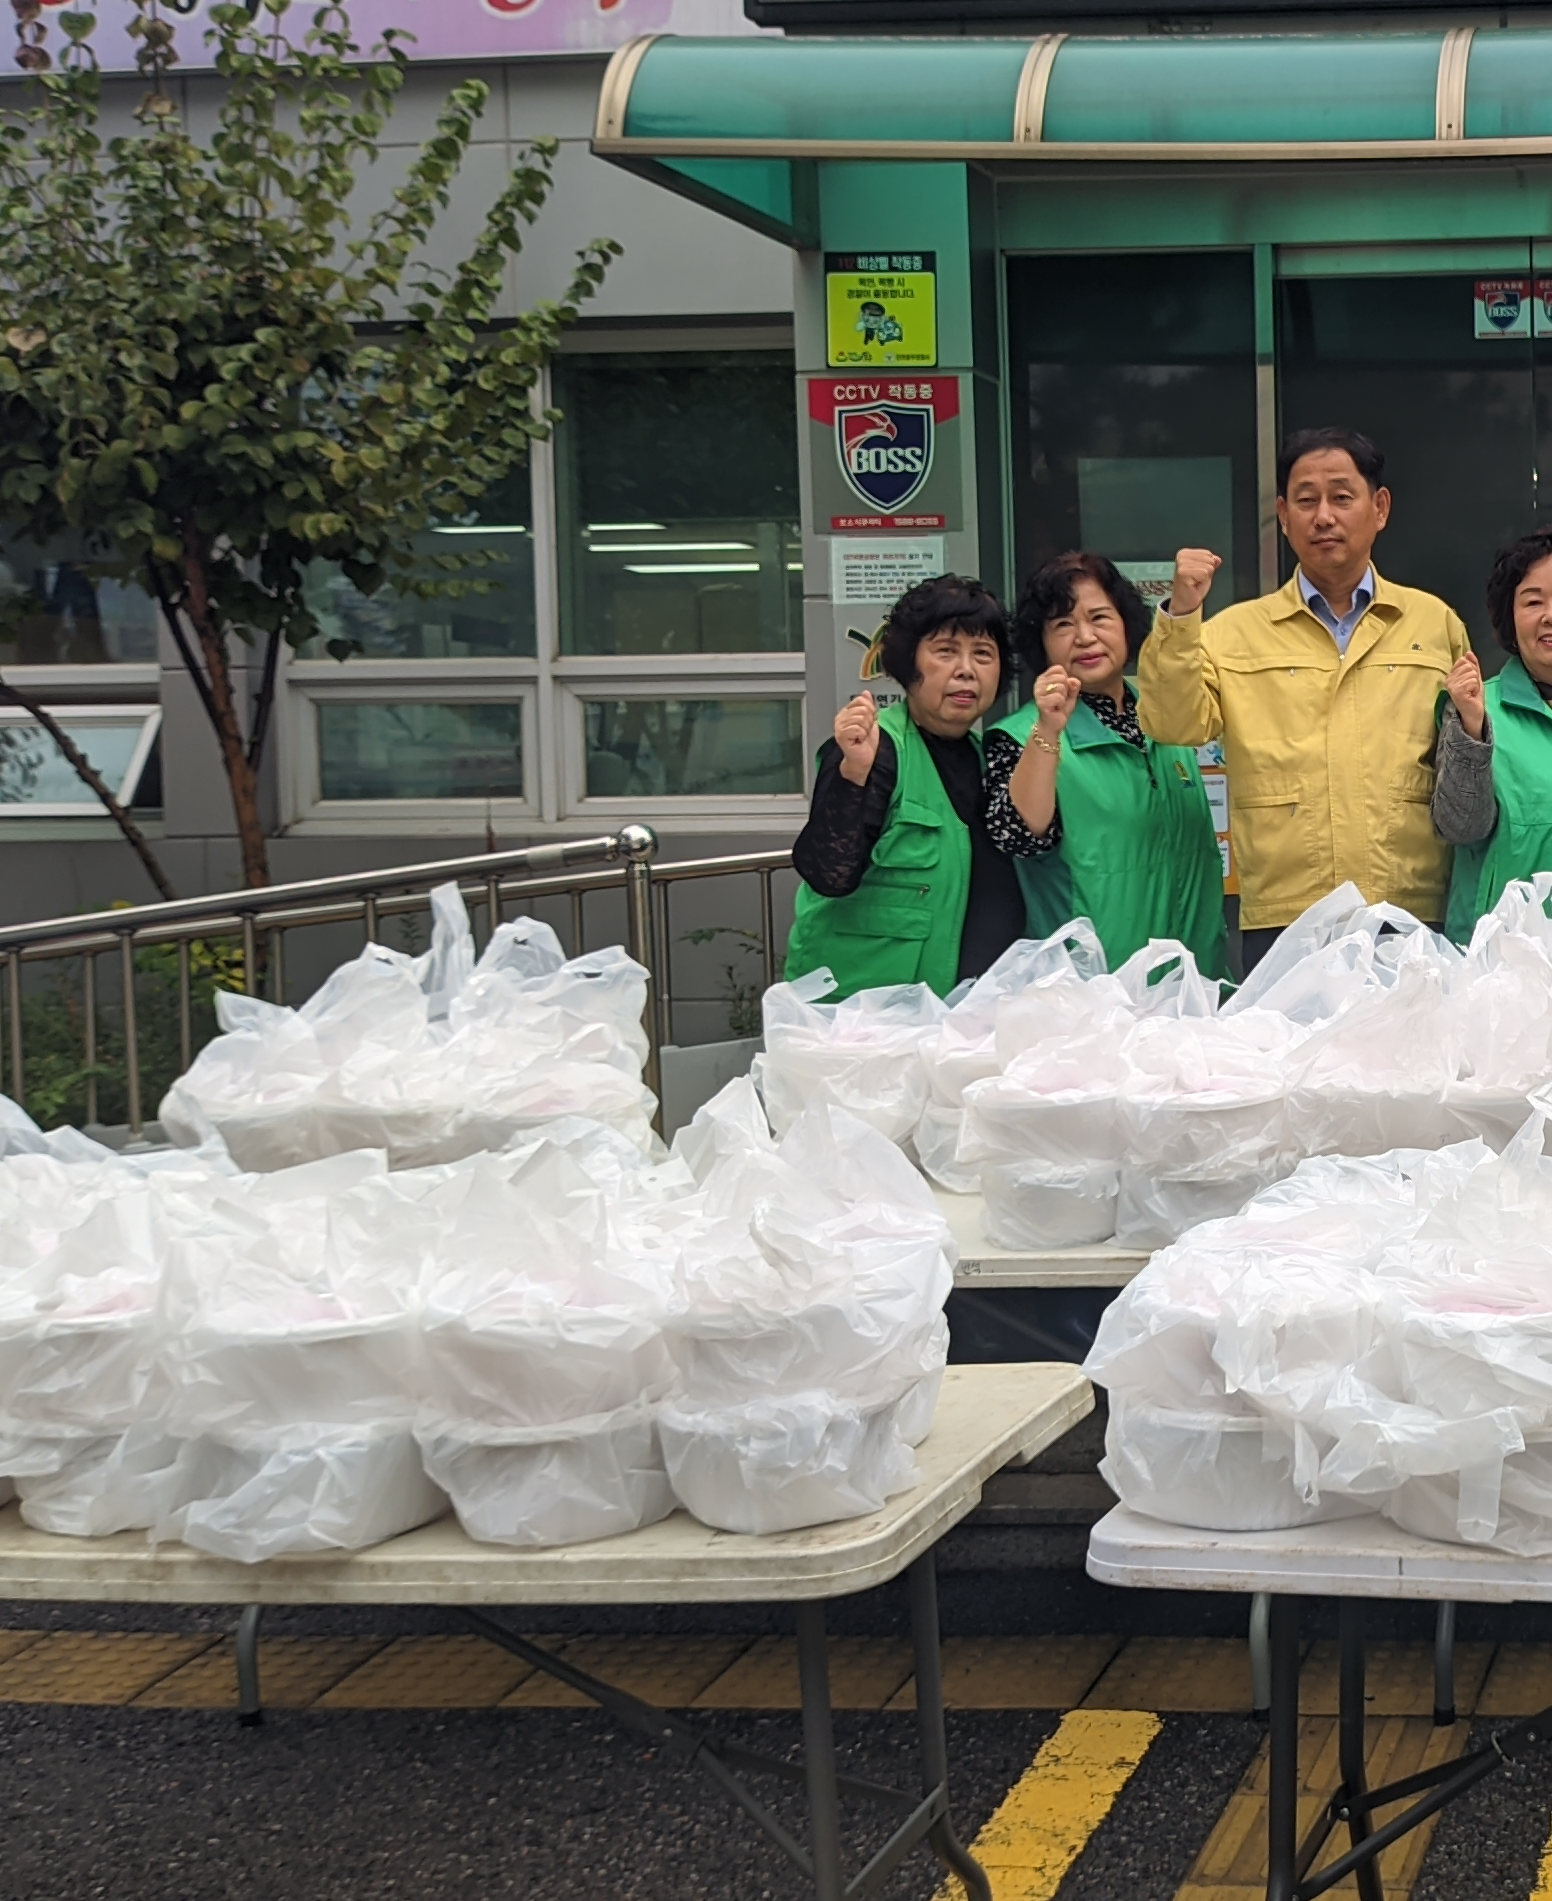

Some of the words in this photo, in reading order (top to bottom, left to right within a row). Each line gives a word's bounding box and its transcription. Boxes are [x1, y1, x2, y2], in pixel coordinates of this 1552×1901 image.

[833, 384, 880, 400] CCTV
[888, 383, 933, 400] 작동중
[851, 447, 923, 473] BOSS
